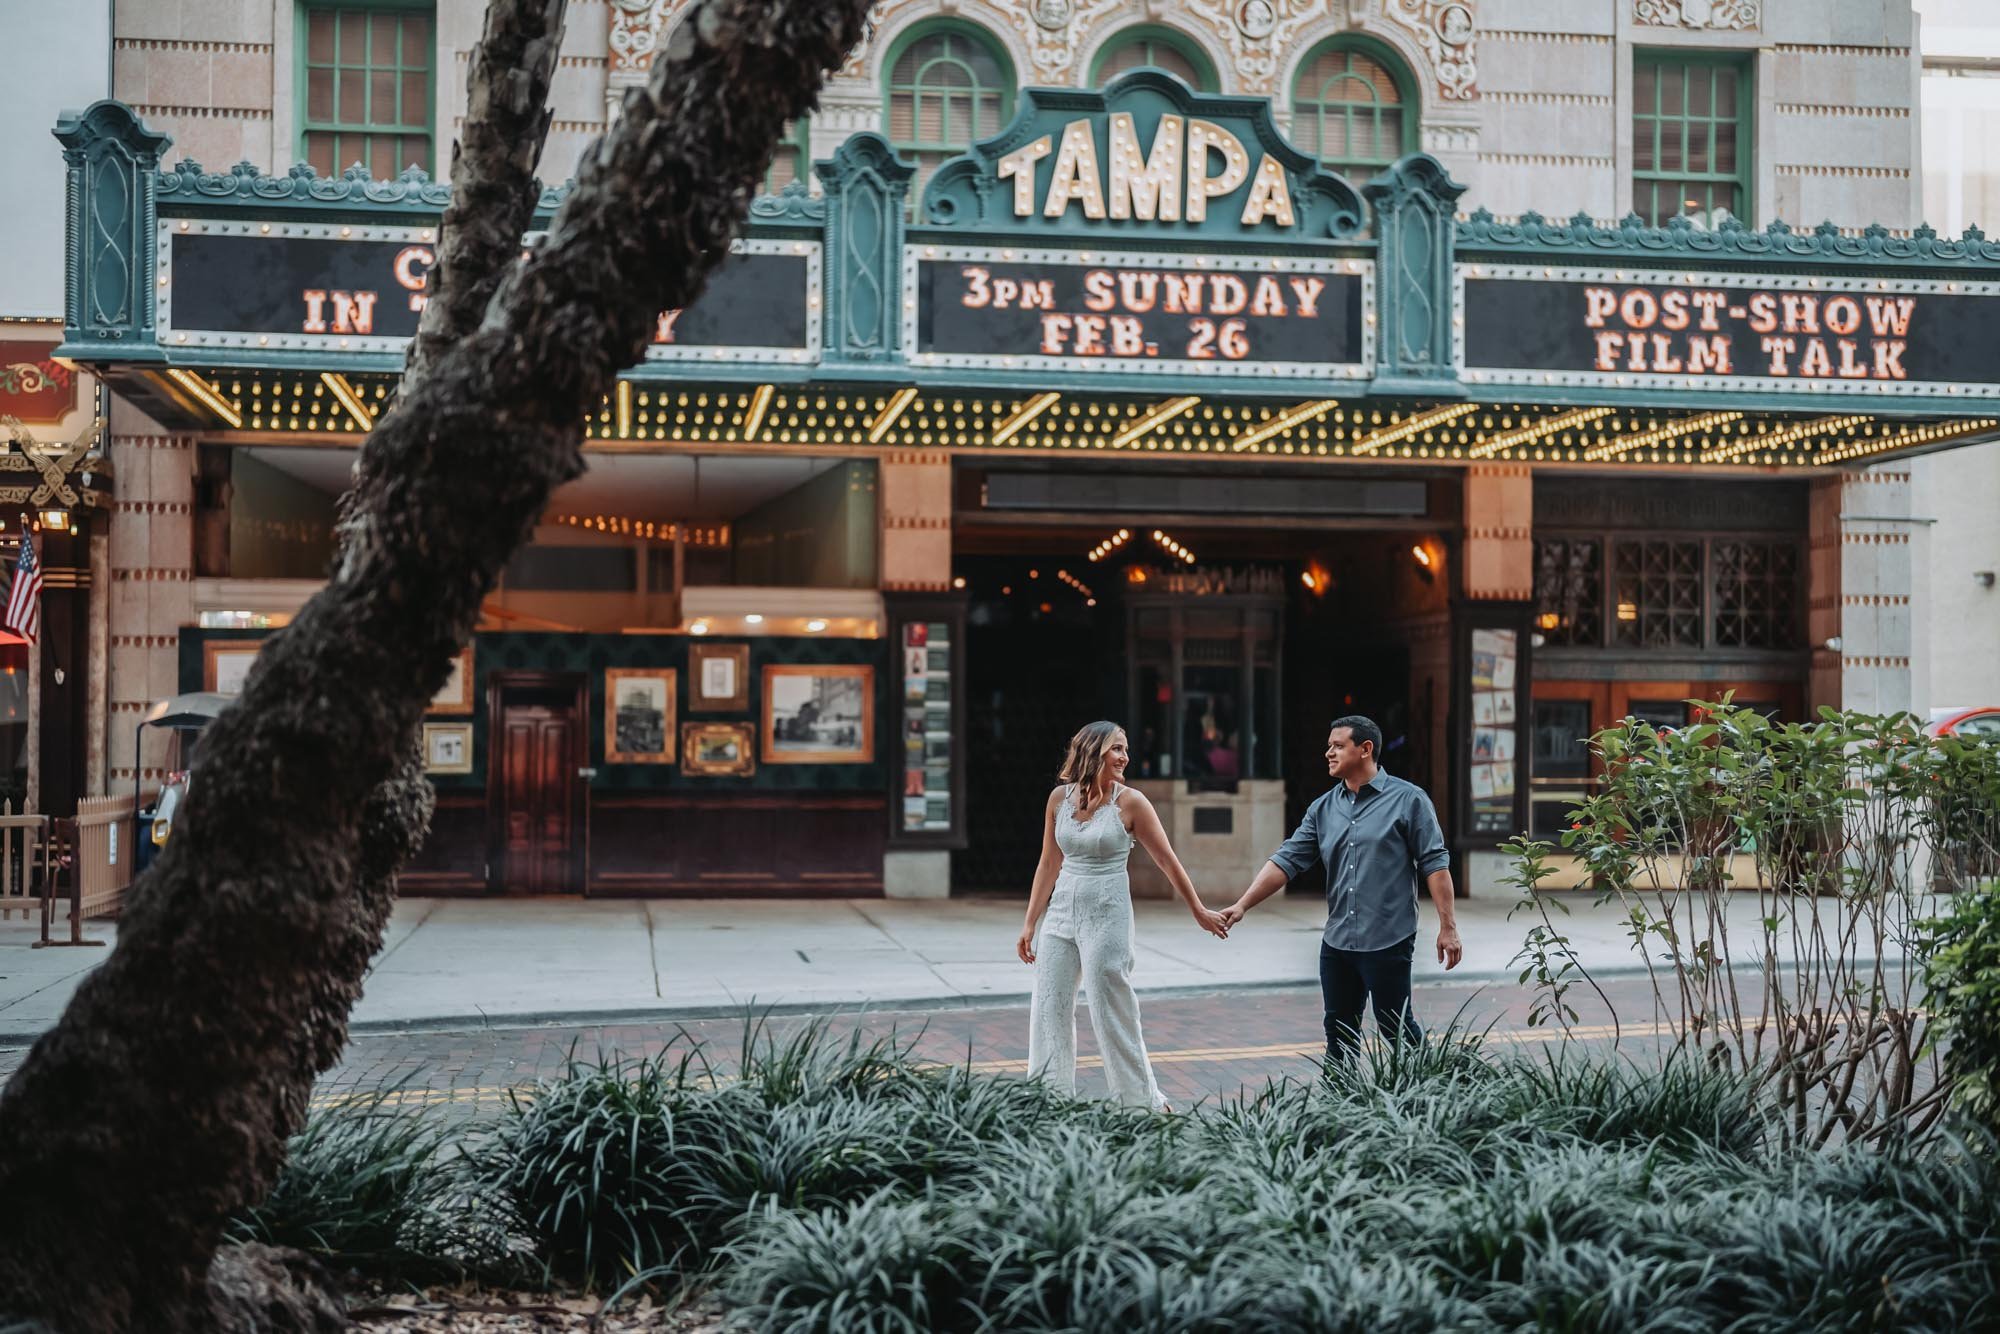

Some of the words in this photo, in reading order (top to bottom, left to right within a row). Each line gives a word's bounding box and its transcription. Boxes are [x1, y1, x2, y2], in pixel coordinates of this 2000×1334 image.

[998, 111, 1296, 226] TAMPA
[303, 290, 378, 334] IN
[963, 267, 1056, 310] 3PM
[1084, 270, 1326, 318] SUNDAY
[1584, 287, 1916, 337] POST-SHOW
[1040, 313, 1159, 357] FEB.
[1187, 317, 1250, 359] 26
[1594, 331, 1733, 374] FILM
[1761, 336, 1907, 379] TALK
